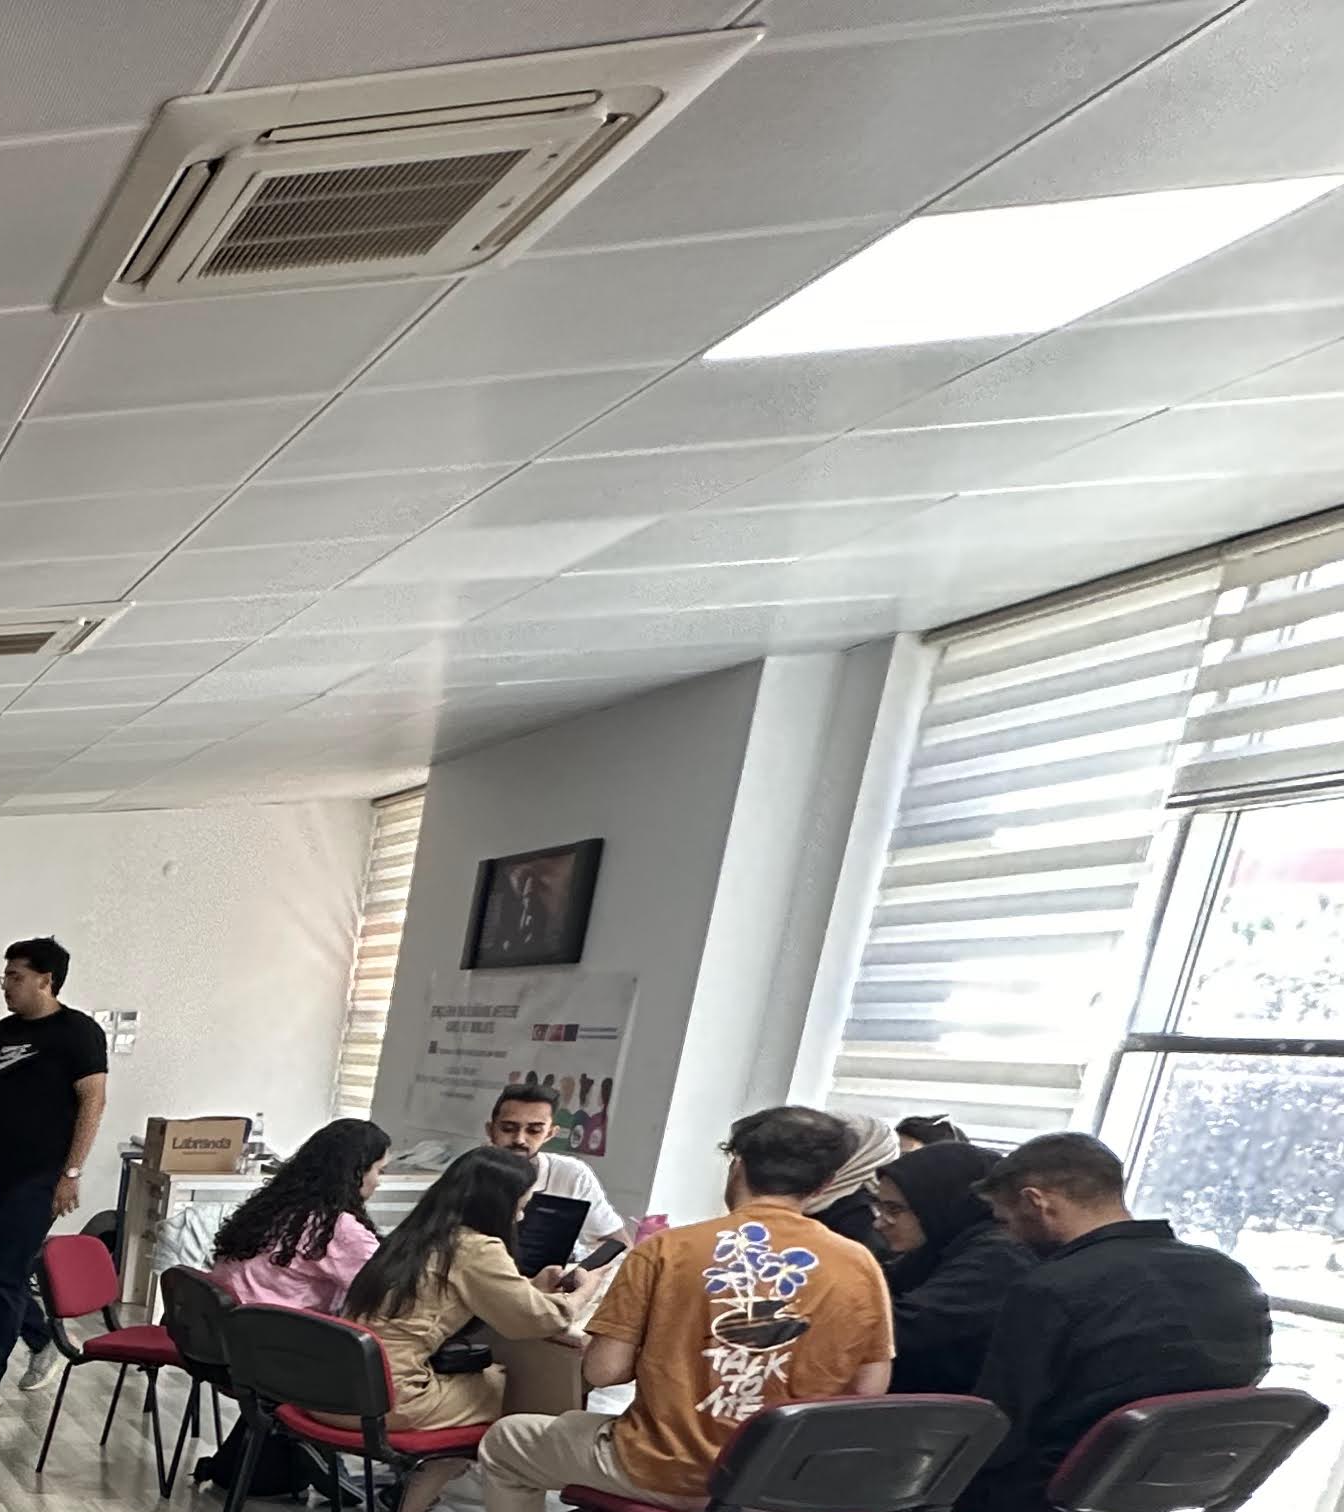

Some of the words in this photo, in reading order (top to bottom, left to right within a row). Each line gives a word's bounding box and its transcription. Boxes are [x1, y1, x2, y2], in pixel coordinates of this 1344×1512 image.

[701, 1346, 793, 1384] TALK
[721, 1372, 764, 1396] TO
[695, 1385, 765, 1421] ME
